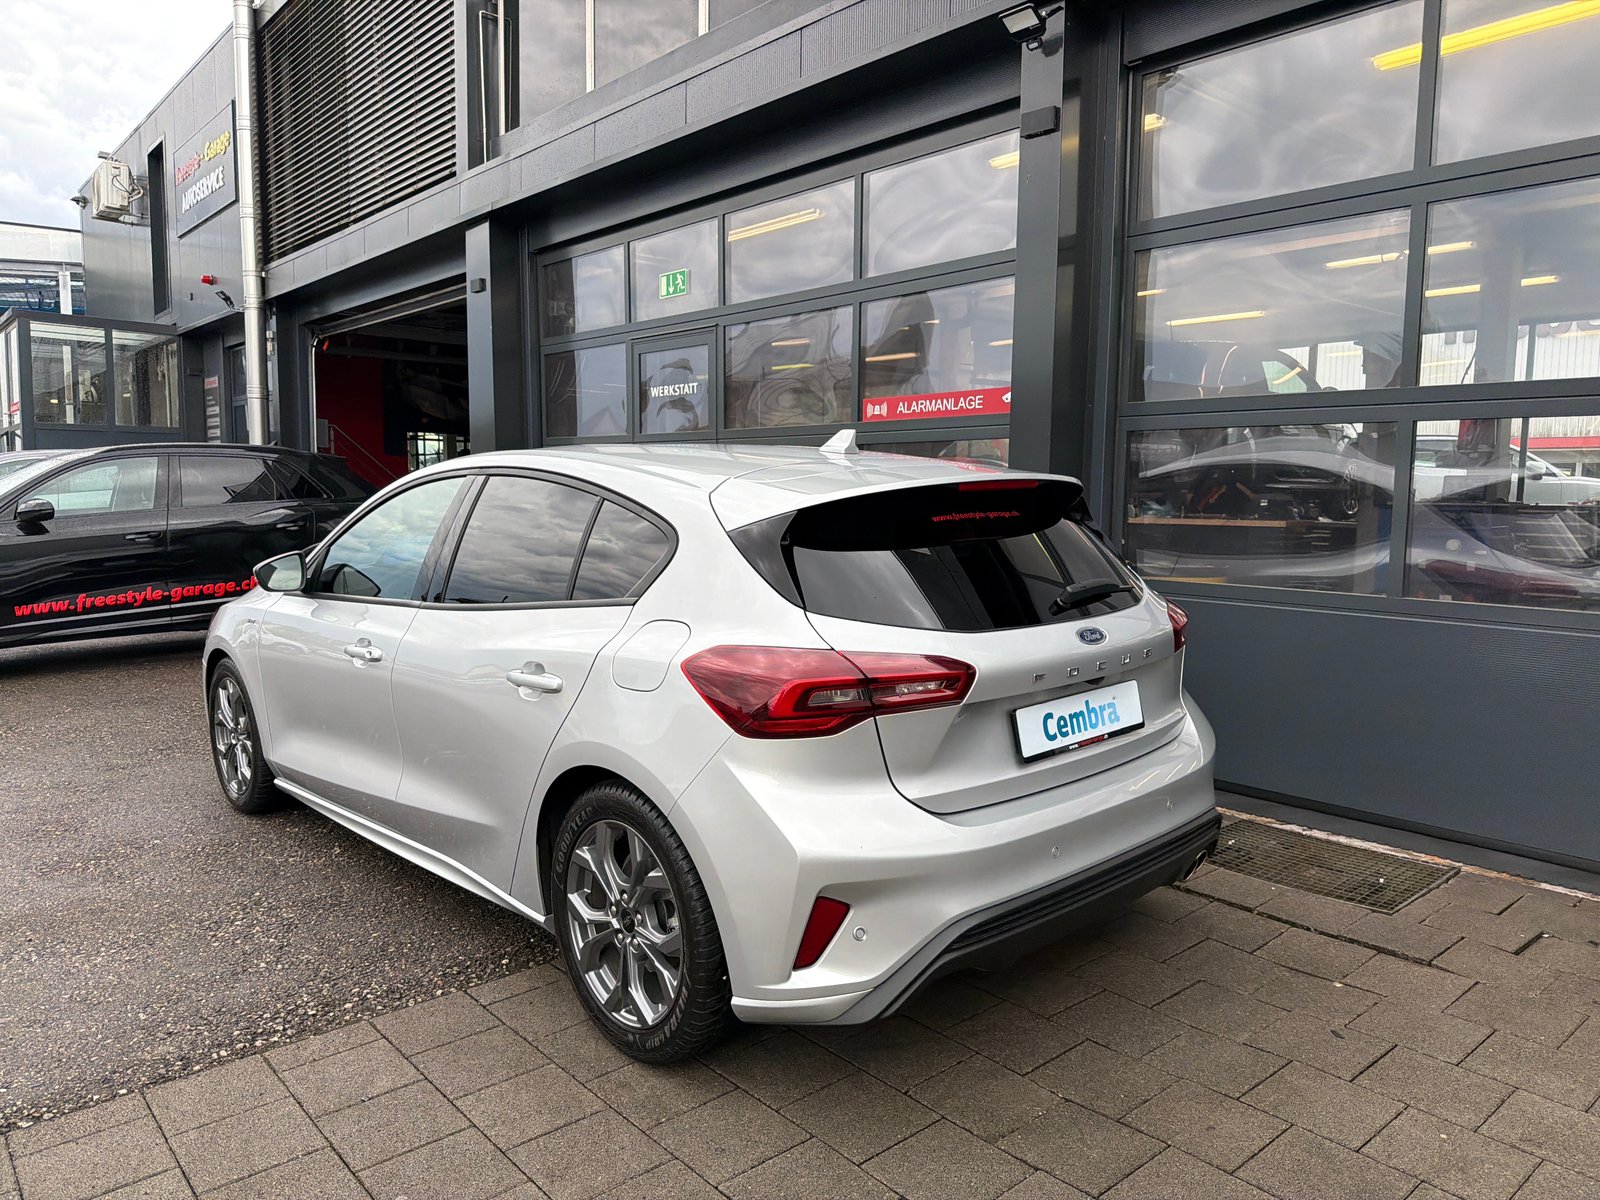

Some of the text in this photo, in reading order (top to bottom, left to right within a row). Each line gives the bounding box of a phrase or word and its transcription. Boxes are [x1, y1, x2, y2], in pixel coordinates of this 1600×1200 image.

[182, 165, 224, 213] AUTOSERVICE
[650, 383, 698, 397] WERKSTATT
[897, 396, 984, 414] ALARMANLAGE
[1032, 648, 1152, 683] FOCUS
[1042, 699, 1120, 742] Cembra
